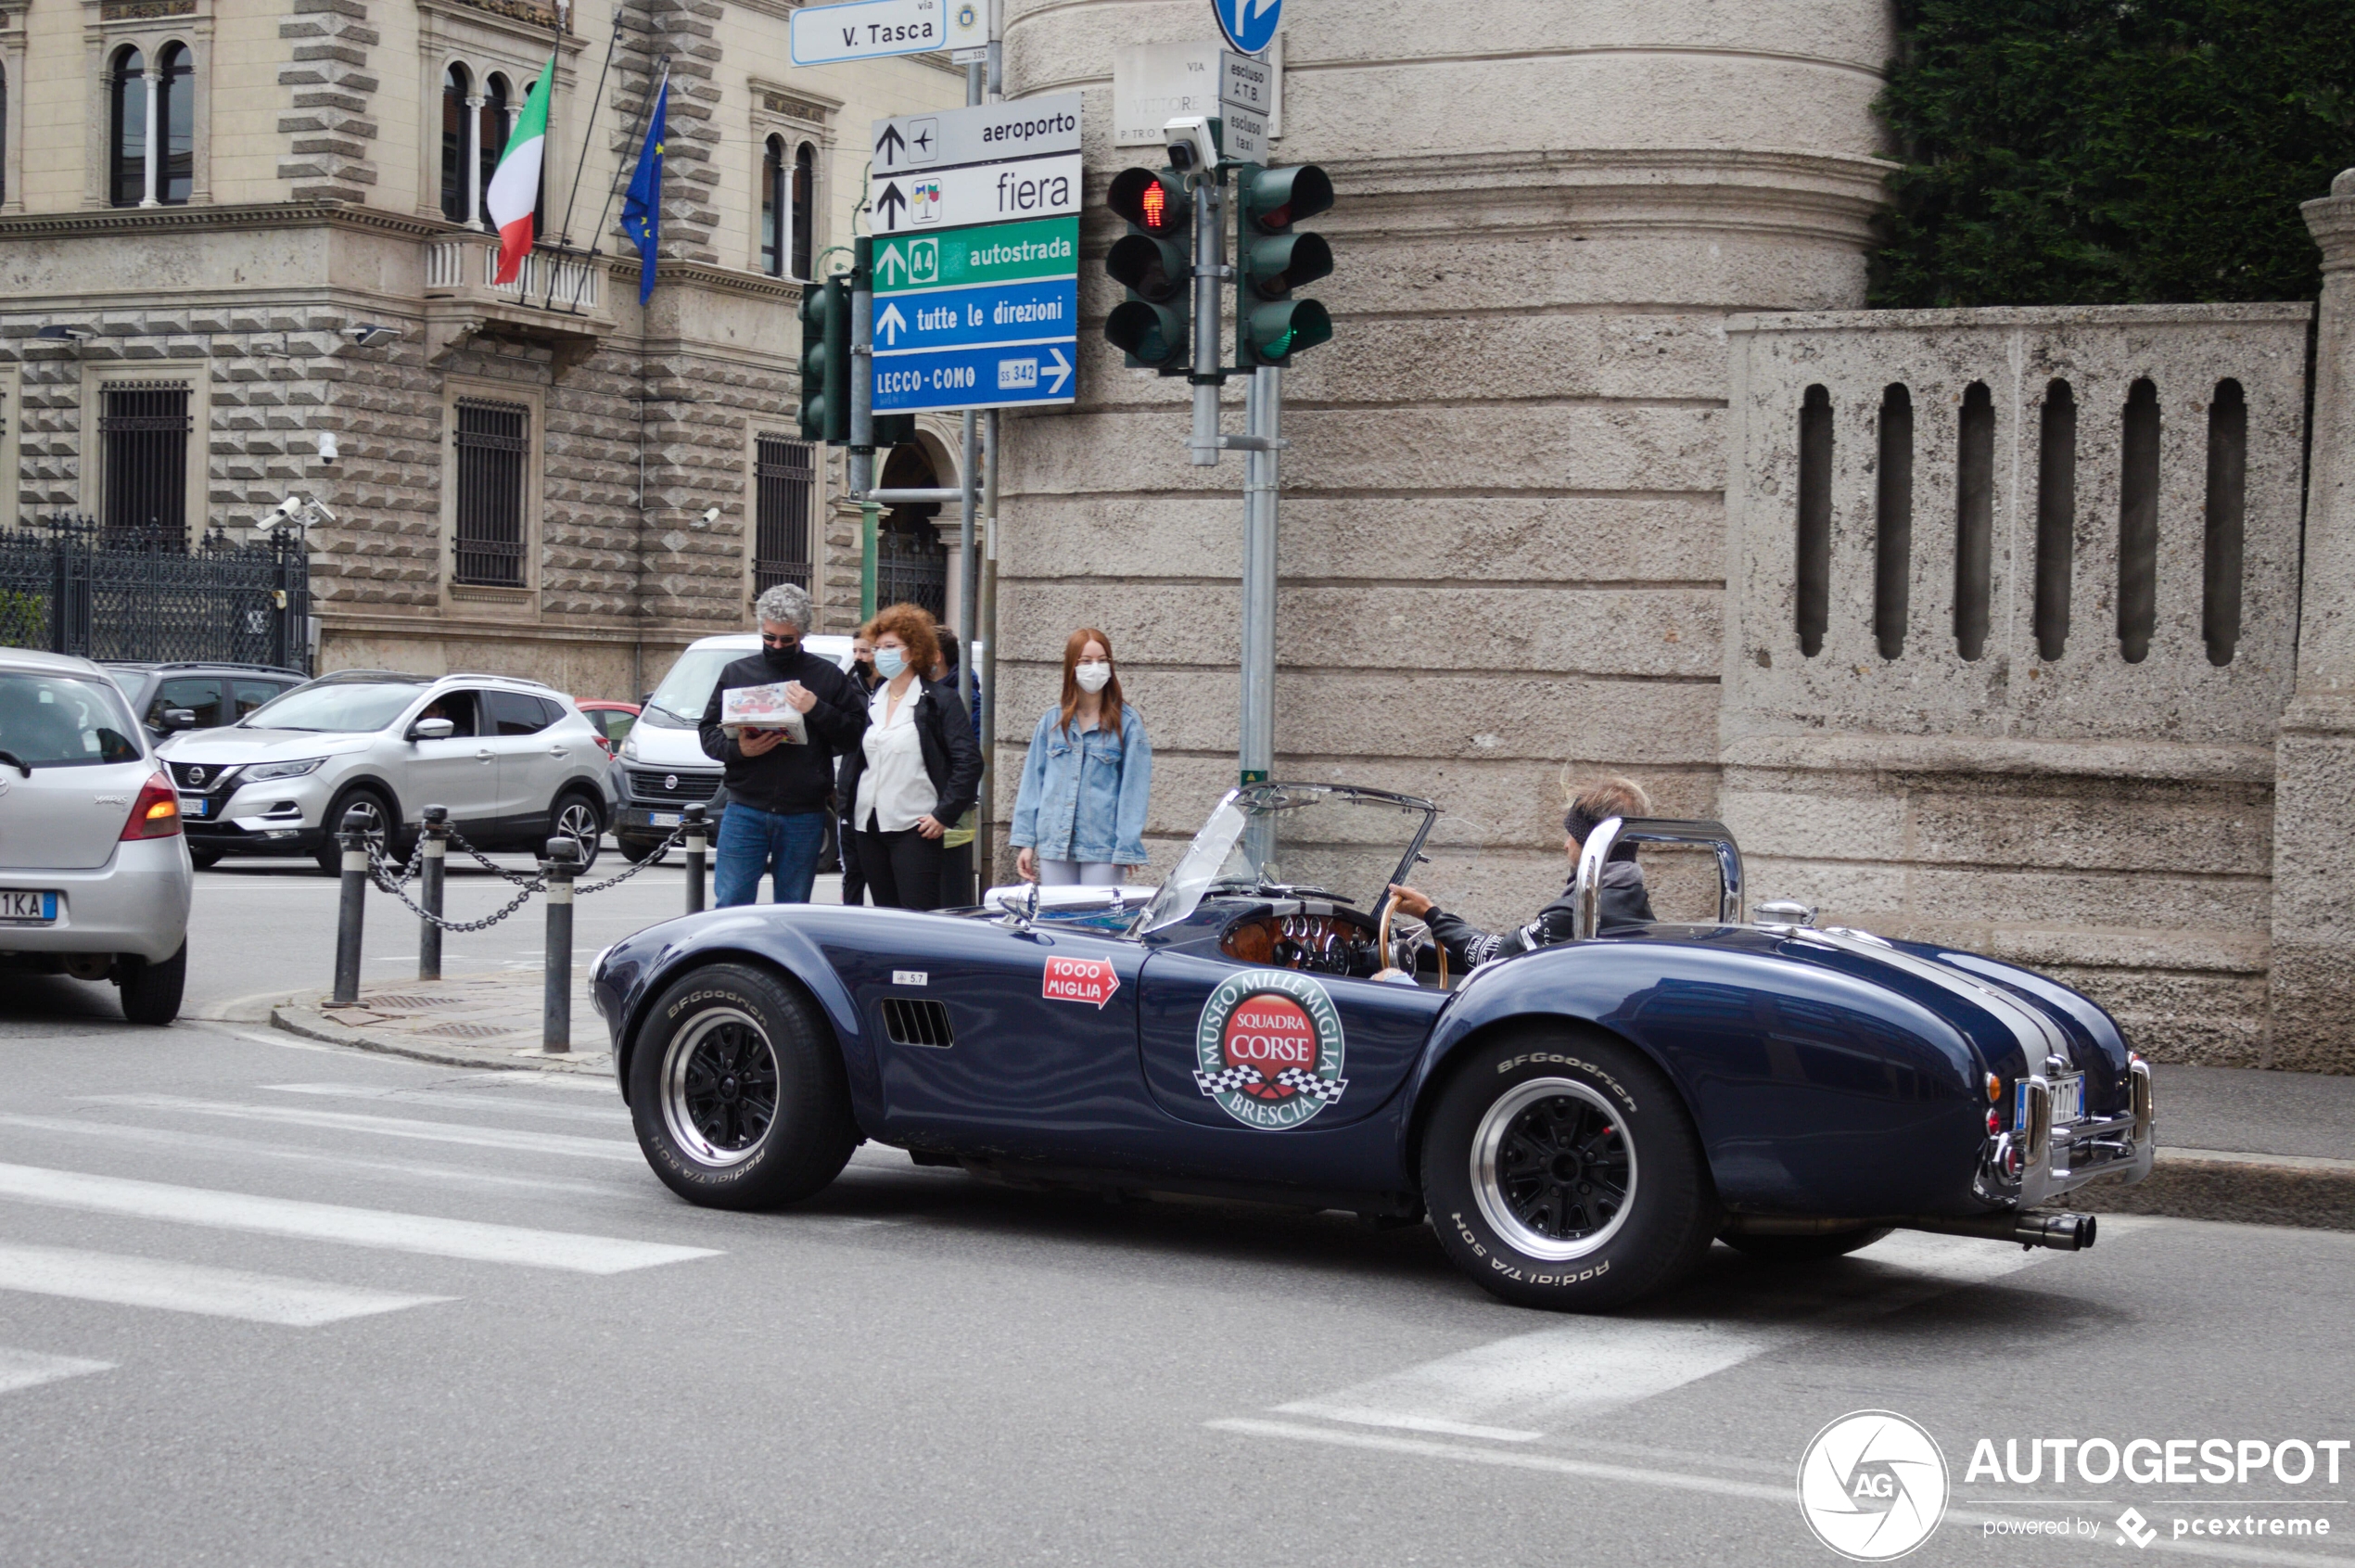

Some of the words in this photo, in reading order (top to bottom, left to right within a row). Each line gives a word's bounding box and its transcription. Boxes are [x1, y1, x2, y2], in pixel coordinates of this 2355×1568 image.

[843, 26, 859, 46] V.
[868, 21, 933, 44] Tasca
[1187, 62, 1204, 72] VIA
[1230, 63, 1265, 83] escluso
[983, 112, 1076, 142] aeroporto
[1230, 114, 1262, 135] escluso
[1235, 134, 1254, 152] taxi
[997, 172, 1069, 212] fiera
[970, 236, 1072, 267] autostrada
[917, 306, 958, 331] tutte
[968, 303, 984, 326] le
[993, 296, 1063, 325] direzioni
[1013, 365, 1035, 381] 342
[910, 974, 923, 983] 5.7
[1053, 962, 1101, 979] 1000
[1048, 979, 1101, 999] MIGLIA
[668, 989, 769, 1026] BFGoodrich
[1202, 986, 1238, 1065] MUSEO
[1241, 973, 1306, 995] MILLE
[1300, 988, 1340, 1072] MIGLIA
[1237, 1013, 1305, 1030] SQUADRA
[1230, 1035, 1309, 1062] CORSE
[1496, 1052, 1638, 1113] BFGoodrich
[1228, 1091, 1316, 1125] BRESCIA
[711, 1148, 766, 1184] Radial
[1491, 1257, 1522, 1281] T/A
[1530, 1259, 1610, 1286] Radial
